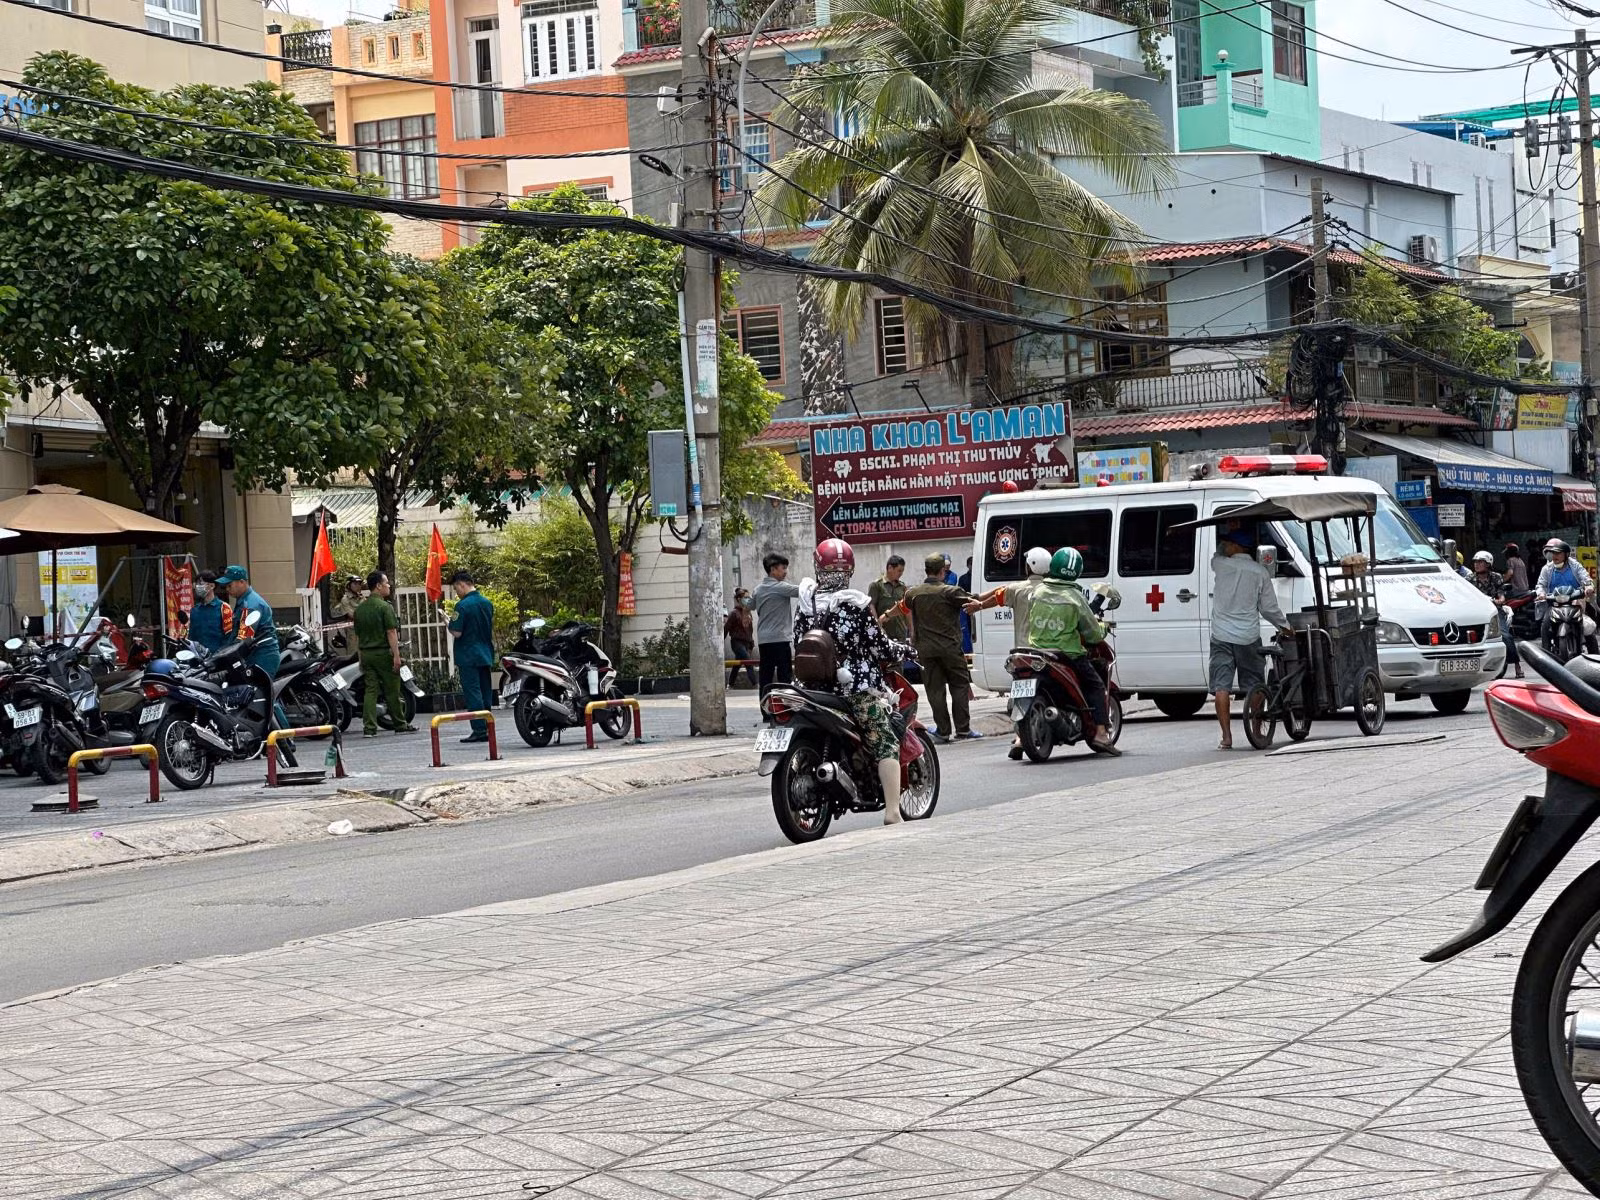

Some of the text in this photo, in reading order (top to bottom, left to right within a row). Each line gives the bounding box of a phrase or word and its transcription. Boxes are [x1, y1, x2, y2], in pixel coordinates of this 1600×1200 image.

[813, 402, 1066, 456] NHA KHOA L'AMAN
[903, 452, 936, 470] PHẠM
[938, 450, 960, 467] THỊ
[963, 448, 987, 462] THU
[989, 442, 1021, 460] THỦY
[817, 465, 1069, 499] BỆNH VIỆN RĂNG HÀM MẶT TRUNG ƯƠNG TPHCM
[1458, 468, 1472, 481] TÍU
[1496, 471, 1512, 484] HÀU
[1513, 474, 1523, 485] 69
[1525, 472, 1535, 485] CÀ
[832, 506, 851, 521] LÊN
[872, 507, 879, 518] 2
[880, 505, 899, 518] KHU
[900, 502, 939, 516] THƯƠNG
[940, 501, 960, 516] MẠI
[834, 523, 845, 535] CC
[847, 521, 877, 534] TOPAZ
[879, 518, 917, 531] GARDEN
[924, 515, 962, 529] CENTER
[1060, 567, 1077, 577] Grab
[995, 611, 1003, 620] XE
[1034, 615, 1066, 631] Grab
[1441, 659, 1454, 671] 51B
